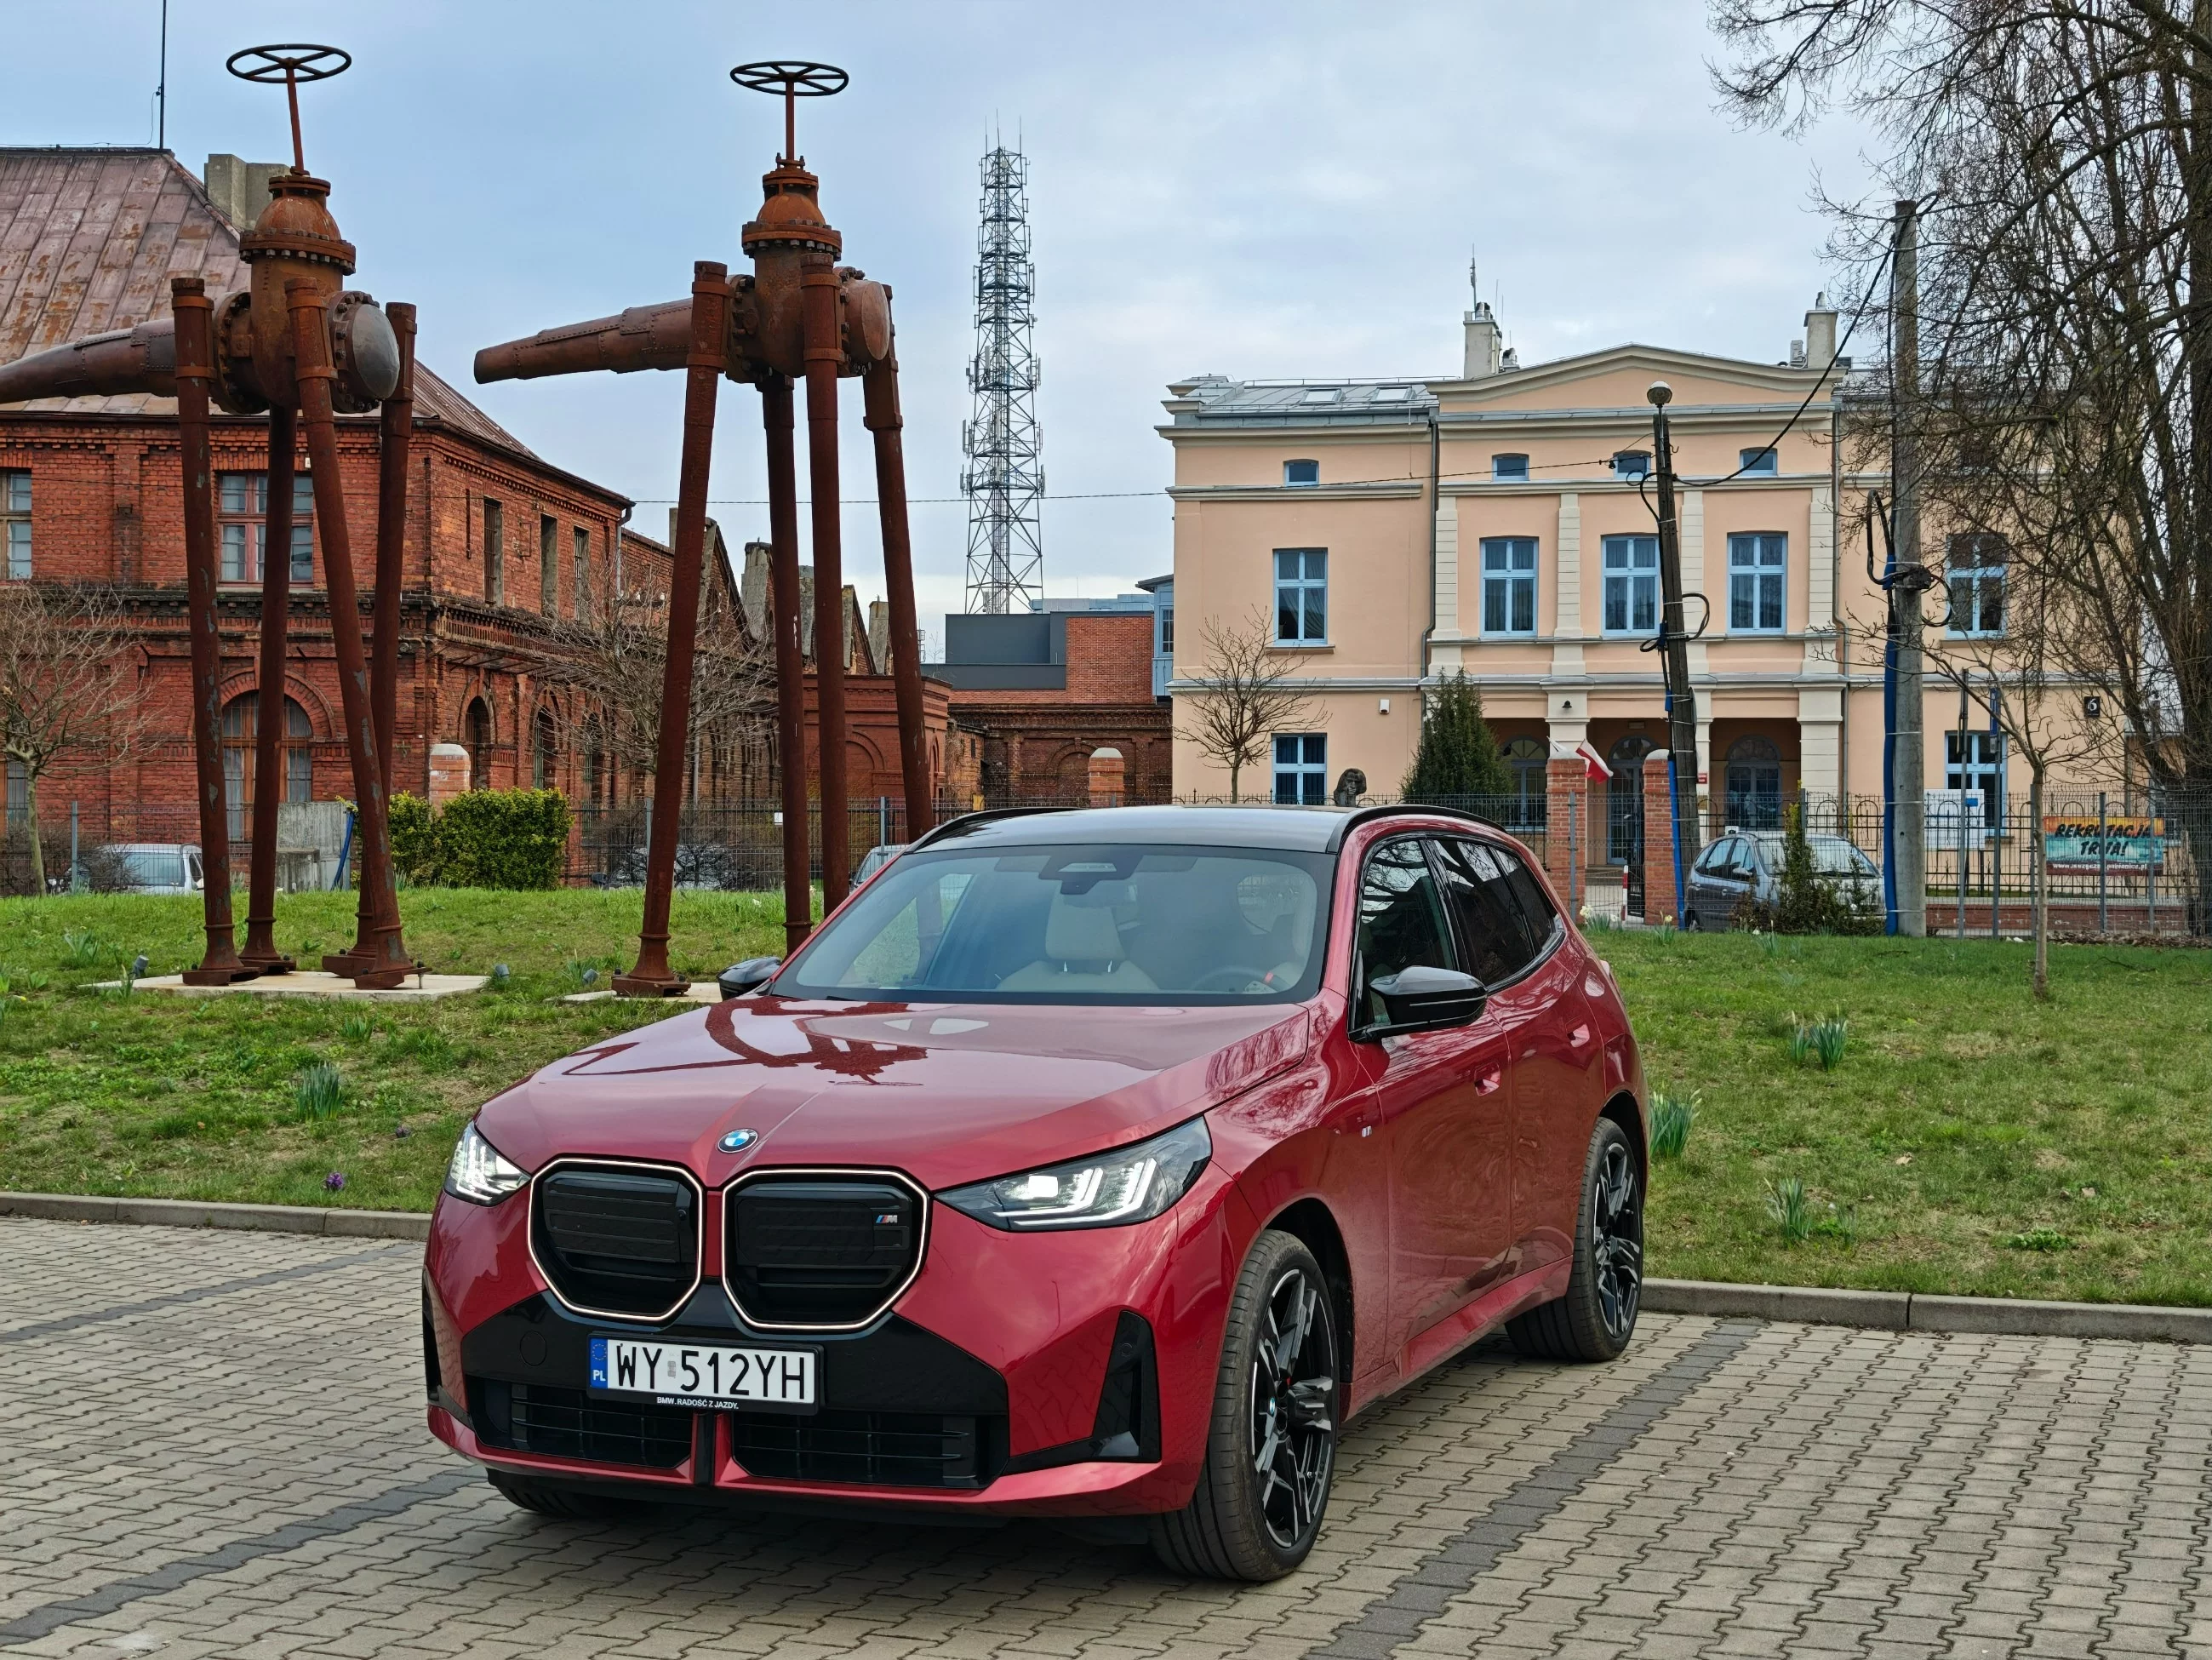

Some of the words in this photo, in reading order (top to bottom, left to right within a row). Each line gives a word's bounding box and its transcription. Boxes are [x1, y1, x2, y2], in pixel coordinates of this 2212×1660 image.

[592, 1370, 606, 1382] PL
[616, 1345, 662, 1389] WY
[680, 1350, 804, 1400] 512YH
[677, 1398, 708, 1407] RADOŚĆ
